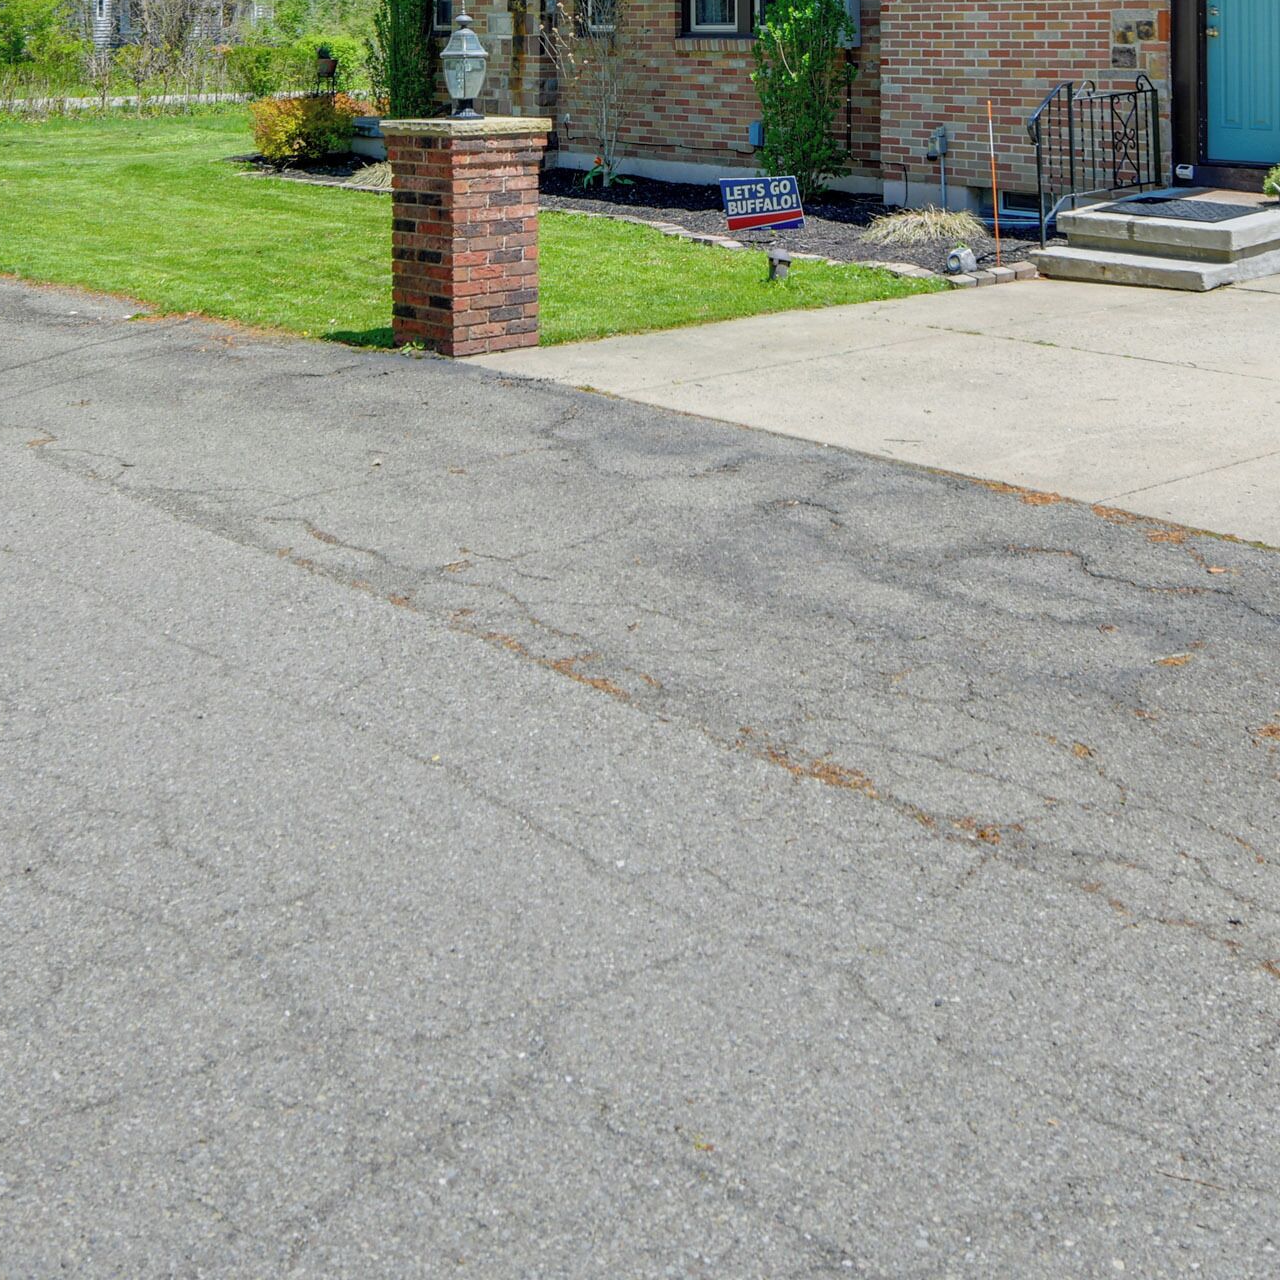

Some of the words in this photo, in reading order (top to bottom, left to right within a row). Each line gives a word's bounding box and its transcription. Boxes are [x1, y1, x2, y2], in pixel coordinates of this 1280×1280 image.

[725, 183, 766, 200] LET'S
[770, 180, 791, 195] GO
[727, 194, 797, 215] BUFFALO!
